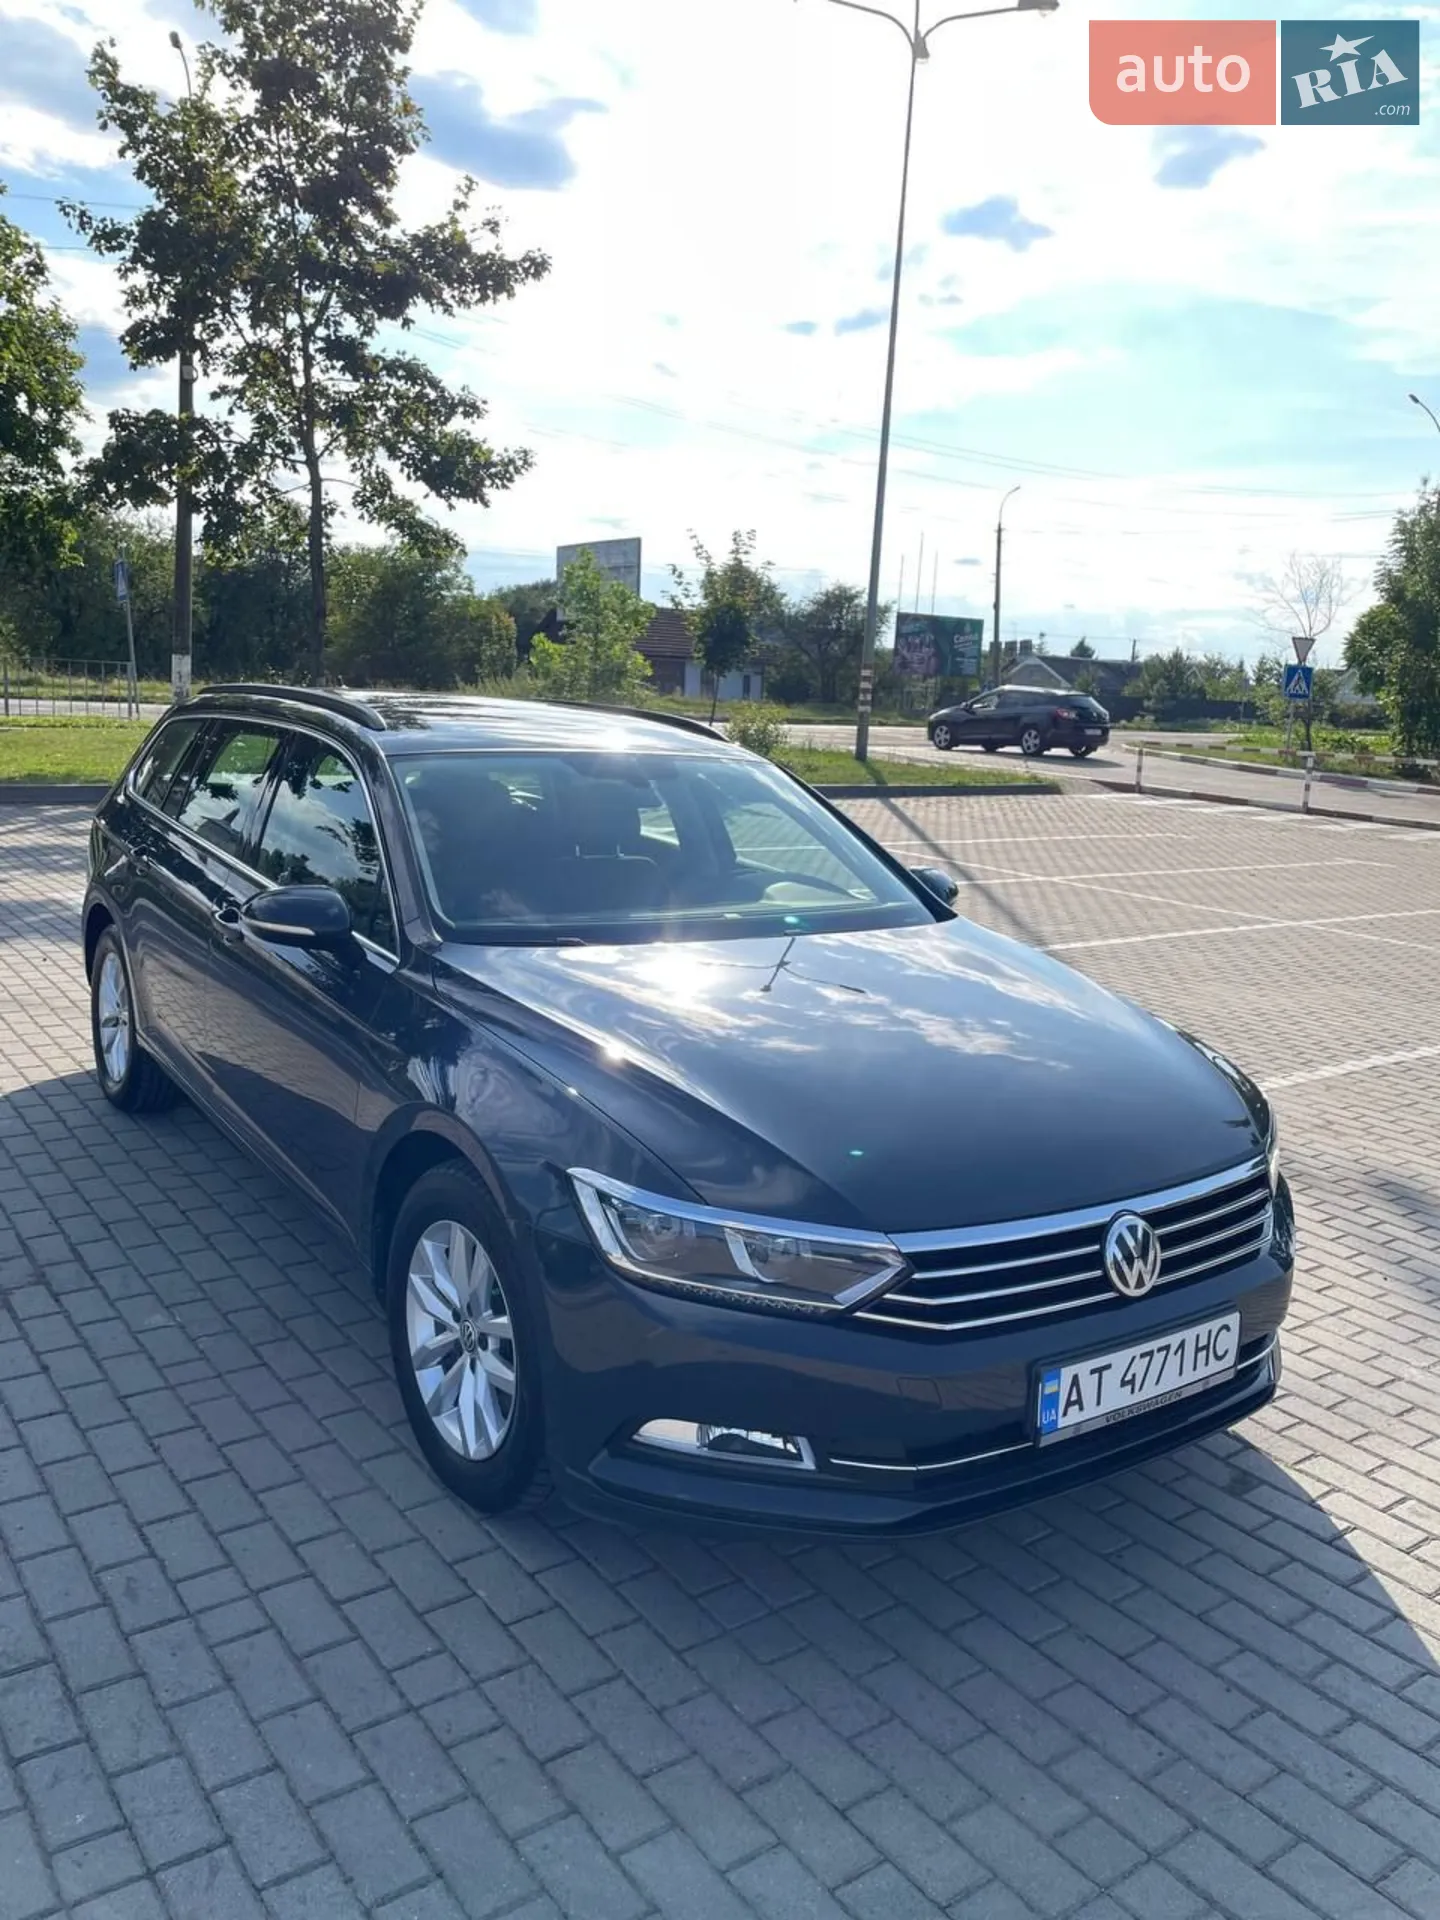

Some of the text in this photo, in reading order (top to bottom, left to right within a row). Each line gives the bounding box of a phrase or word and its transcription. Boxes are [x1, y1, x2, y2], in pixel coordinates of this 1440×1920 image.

[1062, 1324, 1231, 1417] AT 4771 HC
[1042, 1409, 1057, 1424] UA
[1105, 1390, 1183, 1423] VOLKSWAGEN
